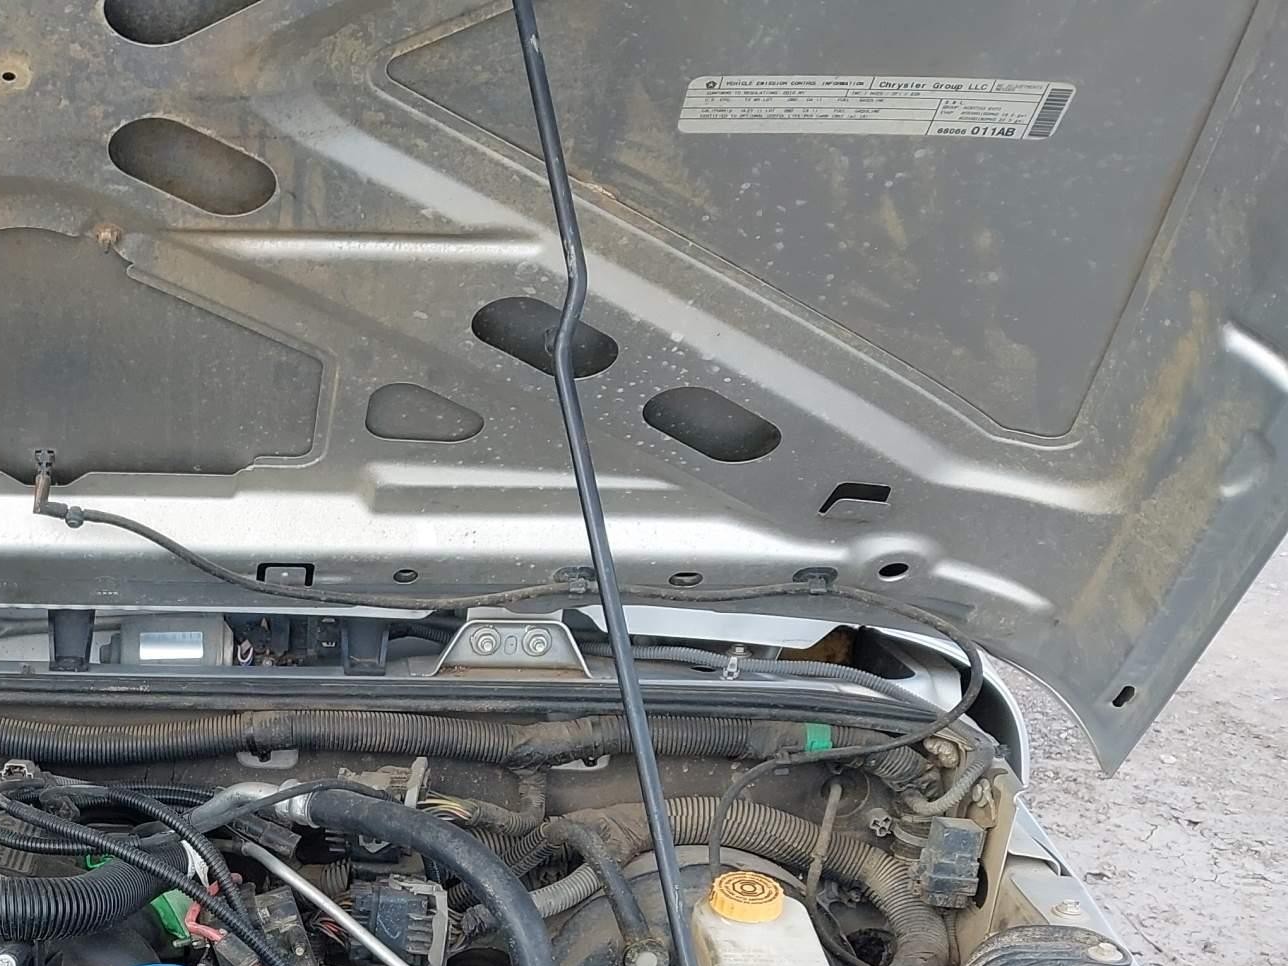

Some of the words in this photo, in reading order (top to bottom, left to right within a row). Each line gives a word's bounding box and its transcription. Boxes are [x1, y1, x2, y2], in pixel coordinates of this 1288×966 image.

[879, 81, 926, 90] Chrysler
[932, 82, 963, 91] Group
[970, 125, 1016, 137] 011AB
